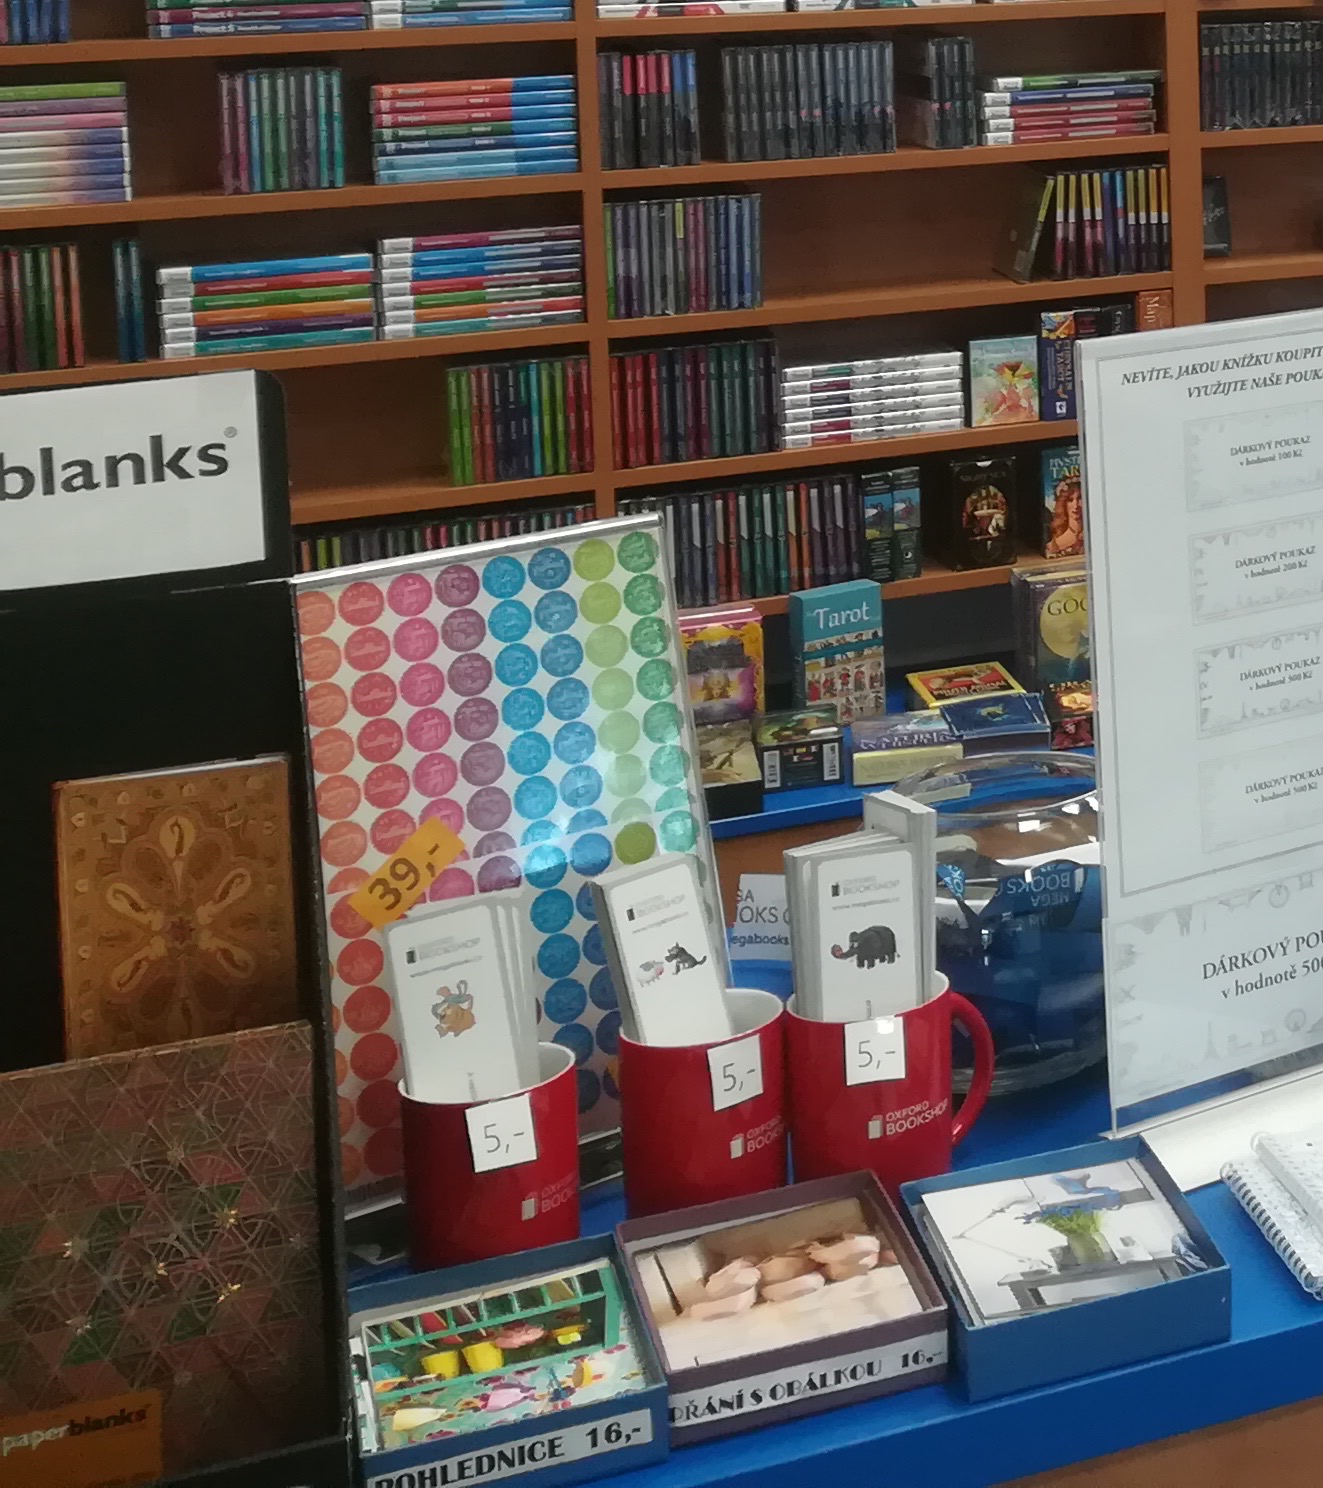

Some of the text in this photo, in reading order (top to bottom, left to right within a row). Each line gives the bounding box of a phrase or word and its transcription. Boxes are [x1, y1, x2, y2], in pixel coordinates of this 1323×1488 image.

[1121, 369, 1173, 385] NEVÍTE,
[1175, 361, 1220, 380] JAKOU
[1222, 352, 1273, 372] KNÍŽKU
[1187, 379, 1248, 398] VYUŽIJTE
[1250, 371, 1283, 390] NAŠE
[1230, 435, 1311, 457] DÁRKOVÝ POUKAZ
[1245, 453, 1276, 467] hodnotě
[1235, 545, 1316, 569] DÁRKOVÝ POUKAZ
[1250, 564, 1281, 579] hodnotě
[811, 601, 871, 631] Tarot
[1239, 656, 1321, 682] DÁRKOVÝ POUKAZ
[1255, 677, 1286, 691] hodnotě
[1245, 776, 1288, 795] DÁRKOVÝ
[1259, 789, 1291, 804] hodnotě
[368, 842, 440, 911] 39,-
[1202, 936, 1292, 980] DÁRKOVÝ
[1221, 988, 1231, 1000] v
[1234, 963, 1298, 997] hodnotě
[857, 1039, 898, 1069] 5,-
[720, 1062, 757, 1094] 5,-
[885, 1100, 930, 1123] OXFORD
[885, 1097, 950, 1137] BOOKSHOP
[483, 1123, 526, 1155] 5,-
[671, 1392, 744, 1424] PŘÁNÍ
[749, 1386, 764, 1403] S
[768, 1358, 882, 1400] OBÁLKOU
[2, 1406, 147, 1456] paperblanks
[585, 1421, 643, 1451] 16,-
